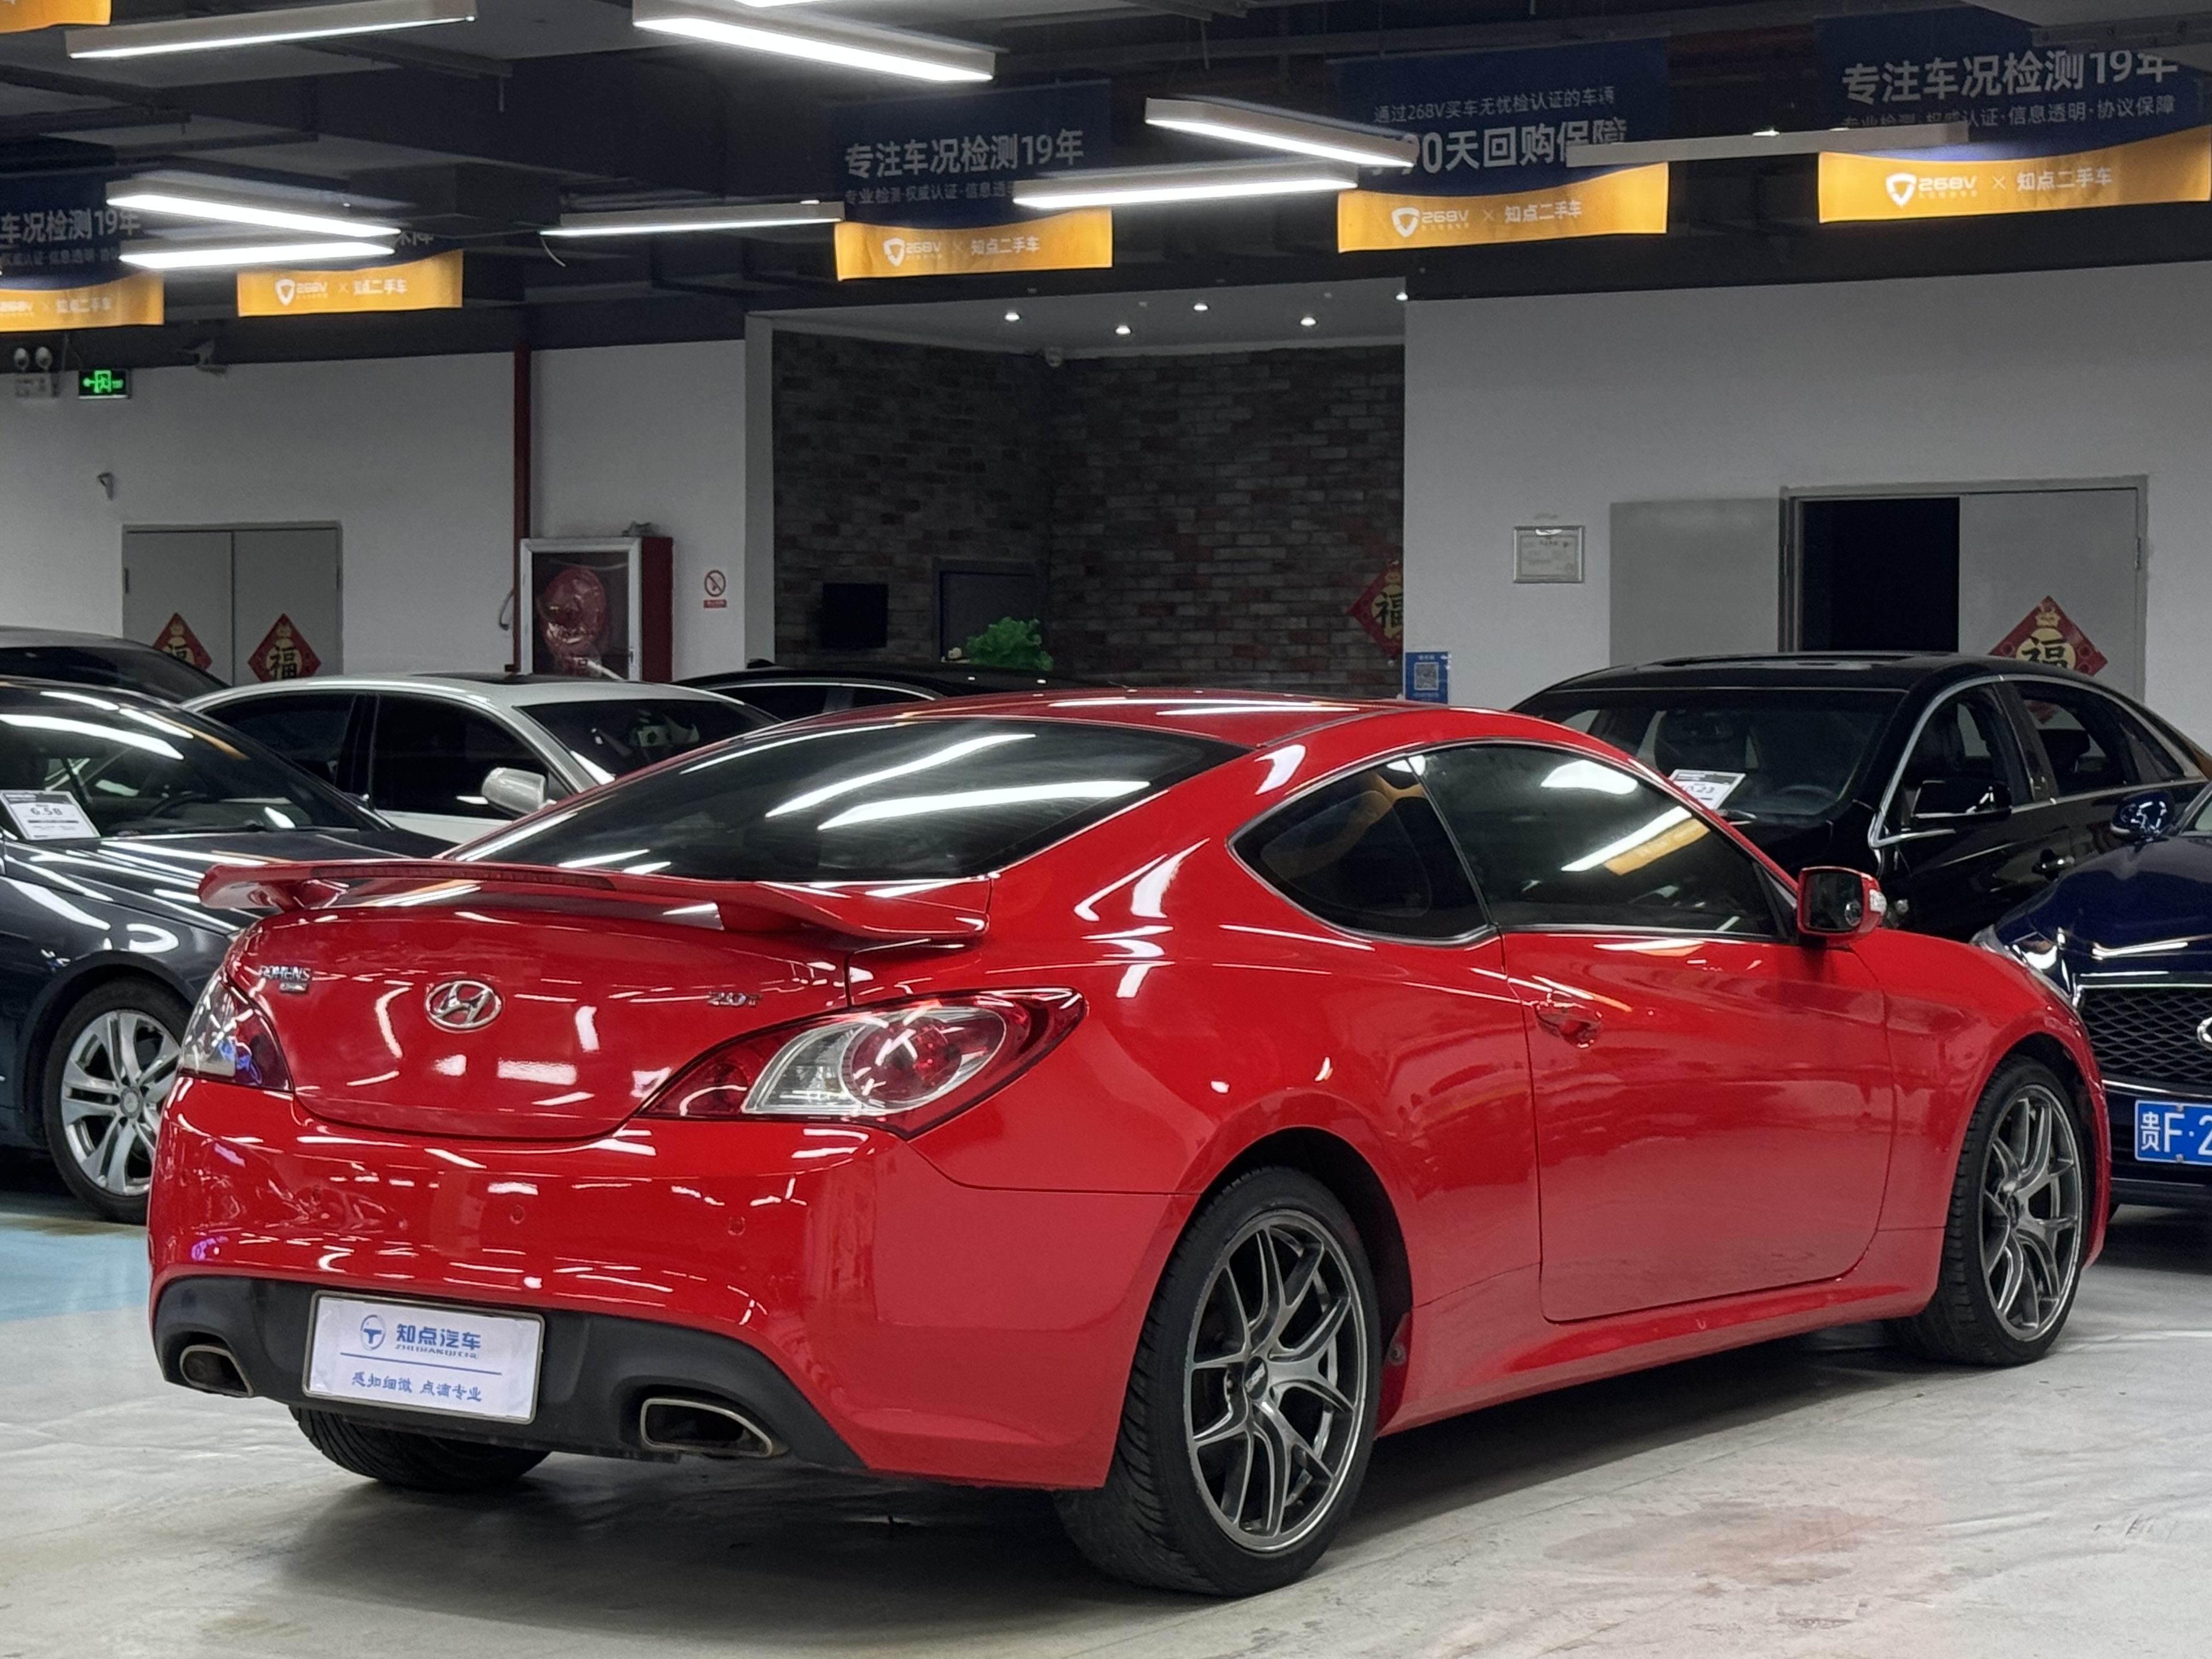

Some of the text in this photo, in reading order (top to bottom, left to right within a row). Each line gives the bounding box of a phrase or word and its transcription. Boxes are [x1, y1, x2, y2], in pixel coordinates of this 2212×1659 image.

[1842, 49, 2178, 105] 专注车况检测19年
[844, 128, 1085, 179] 专注车况检测19年
[1918, 176, 1978, 192] 268V
[2016, 167, 2112, 192] 知点二手车
[1421, 210, 1469, 224] 268V
[1504, 200, 1582, 224] 知点二手车
[396, 1324, 482, 1351] 知点汽车
